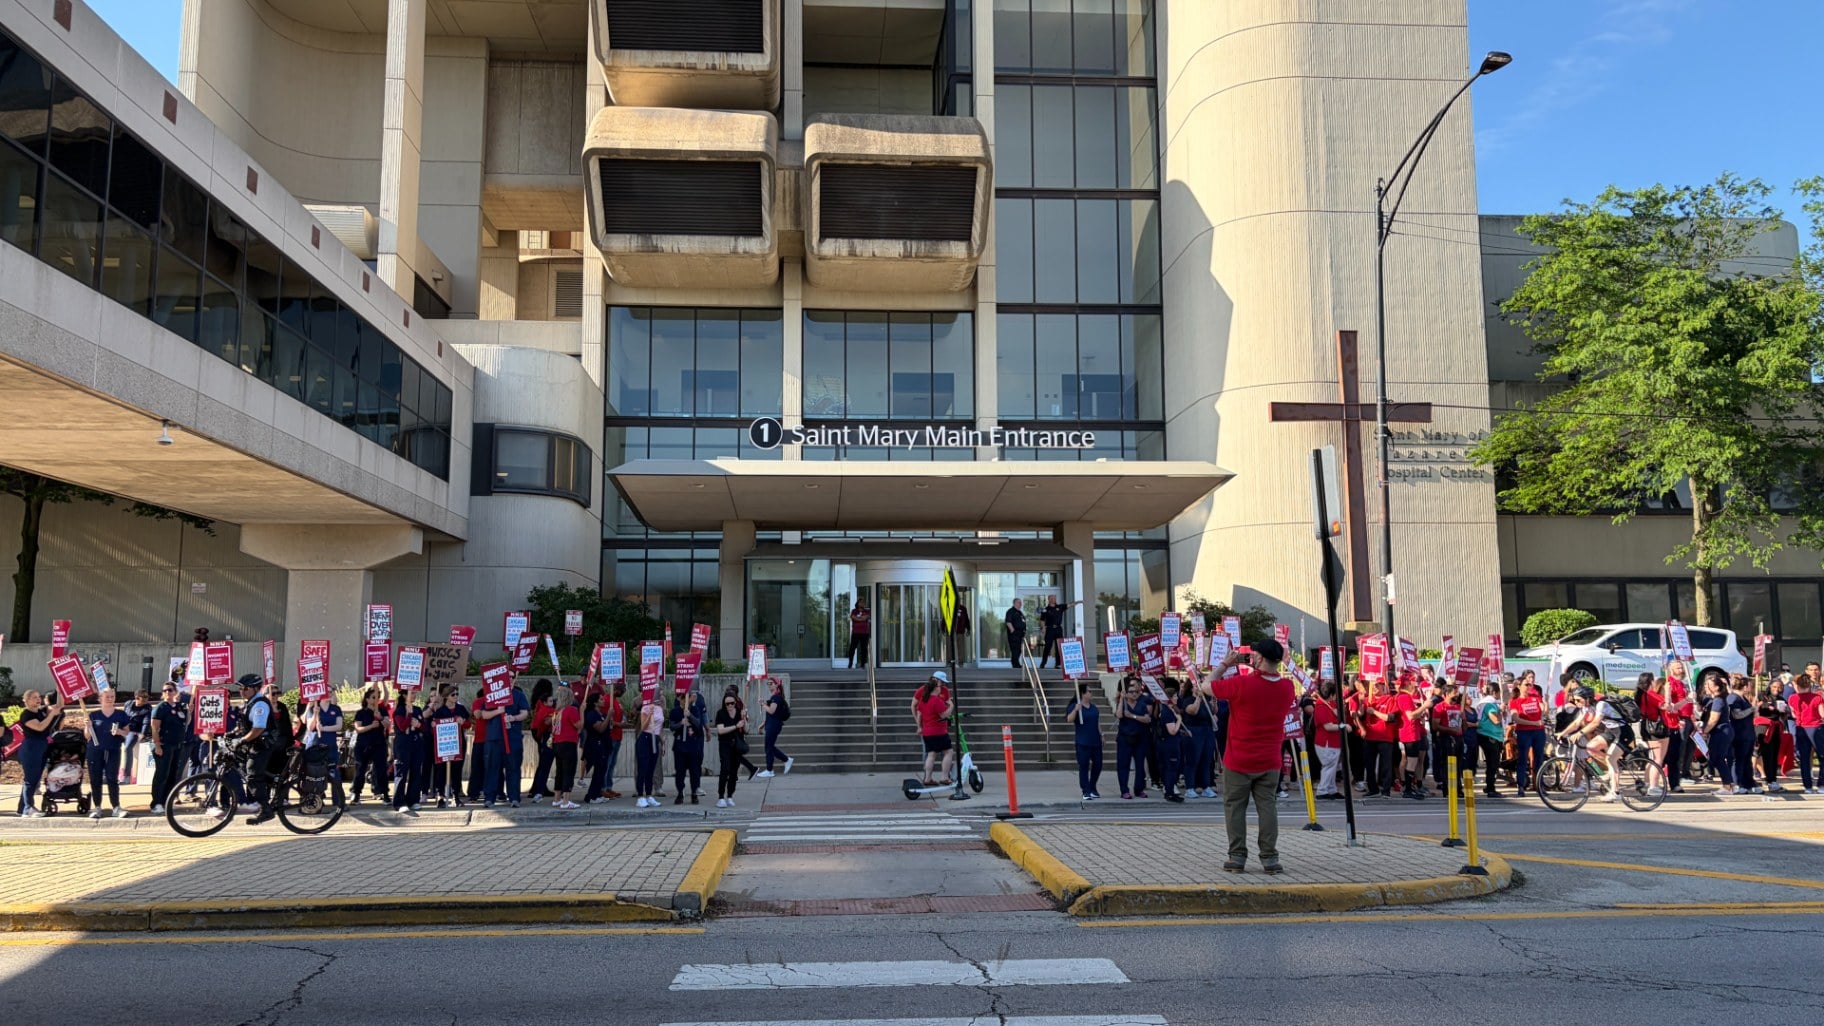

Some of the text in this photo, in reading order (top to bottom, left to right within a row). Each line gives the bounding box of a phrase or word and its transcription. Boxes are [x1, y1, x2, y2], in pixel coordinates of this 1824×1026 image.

[759, 423, 1095, 450] 1 Saint Mary Main Entrance
[1420, 428, 1458, 445] Mary
[1376, 465, 1485, 482] ospital Center
[520, 636, 538, 644] NURSES
[1138, 636, 1159, 650] NURSES
[304, 647, 327, 656] SAFE
[519, 648, 531, 657] ULP
[1144, 651, 1157, 660] ULP
[54, 655, 70, 665] NNU
[513, 655, 532, 665] STRIKE
[1141, 657, 1163, 670] STRIKE
[483, 665, 508, 679] NURSES
[490, 681, 504, 691] ULP
[486, 687, 511, 702] STRIKE
